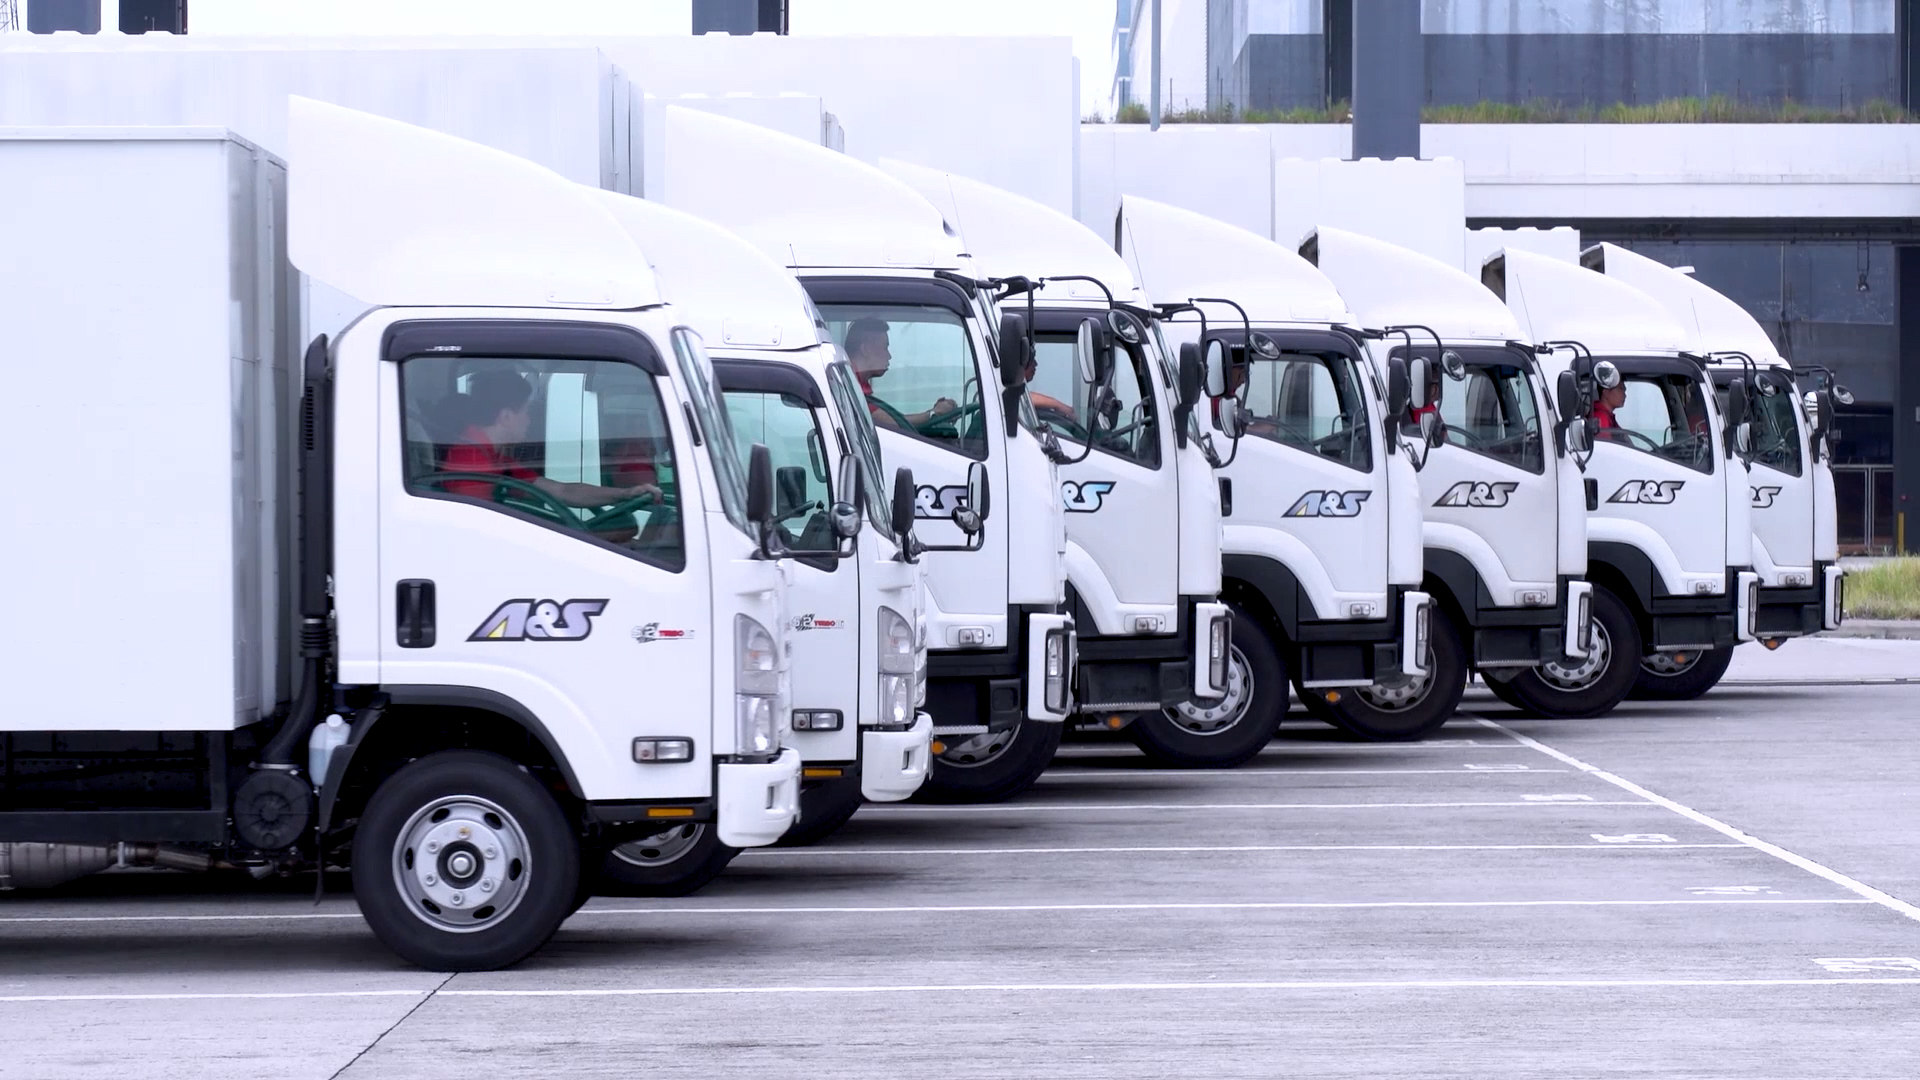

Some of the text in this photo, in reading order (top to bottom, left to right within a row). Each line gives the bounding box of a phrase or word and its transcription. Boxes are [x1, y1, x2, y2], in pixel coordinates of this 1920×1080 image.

[1282, 490, 1373, 518] A&S
[1432, 481, 1520, 507] A&S
[1606, 480, 1686, 505] A&S
[466, 598, 610, 642] A&S
